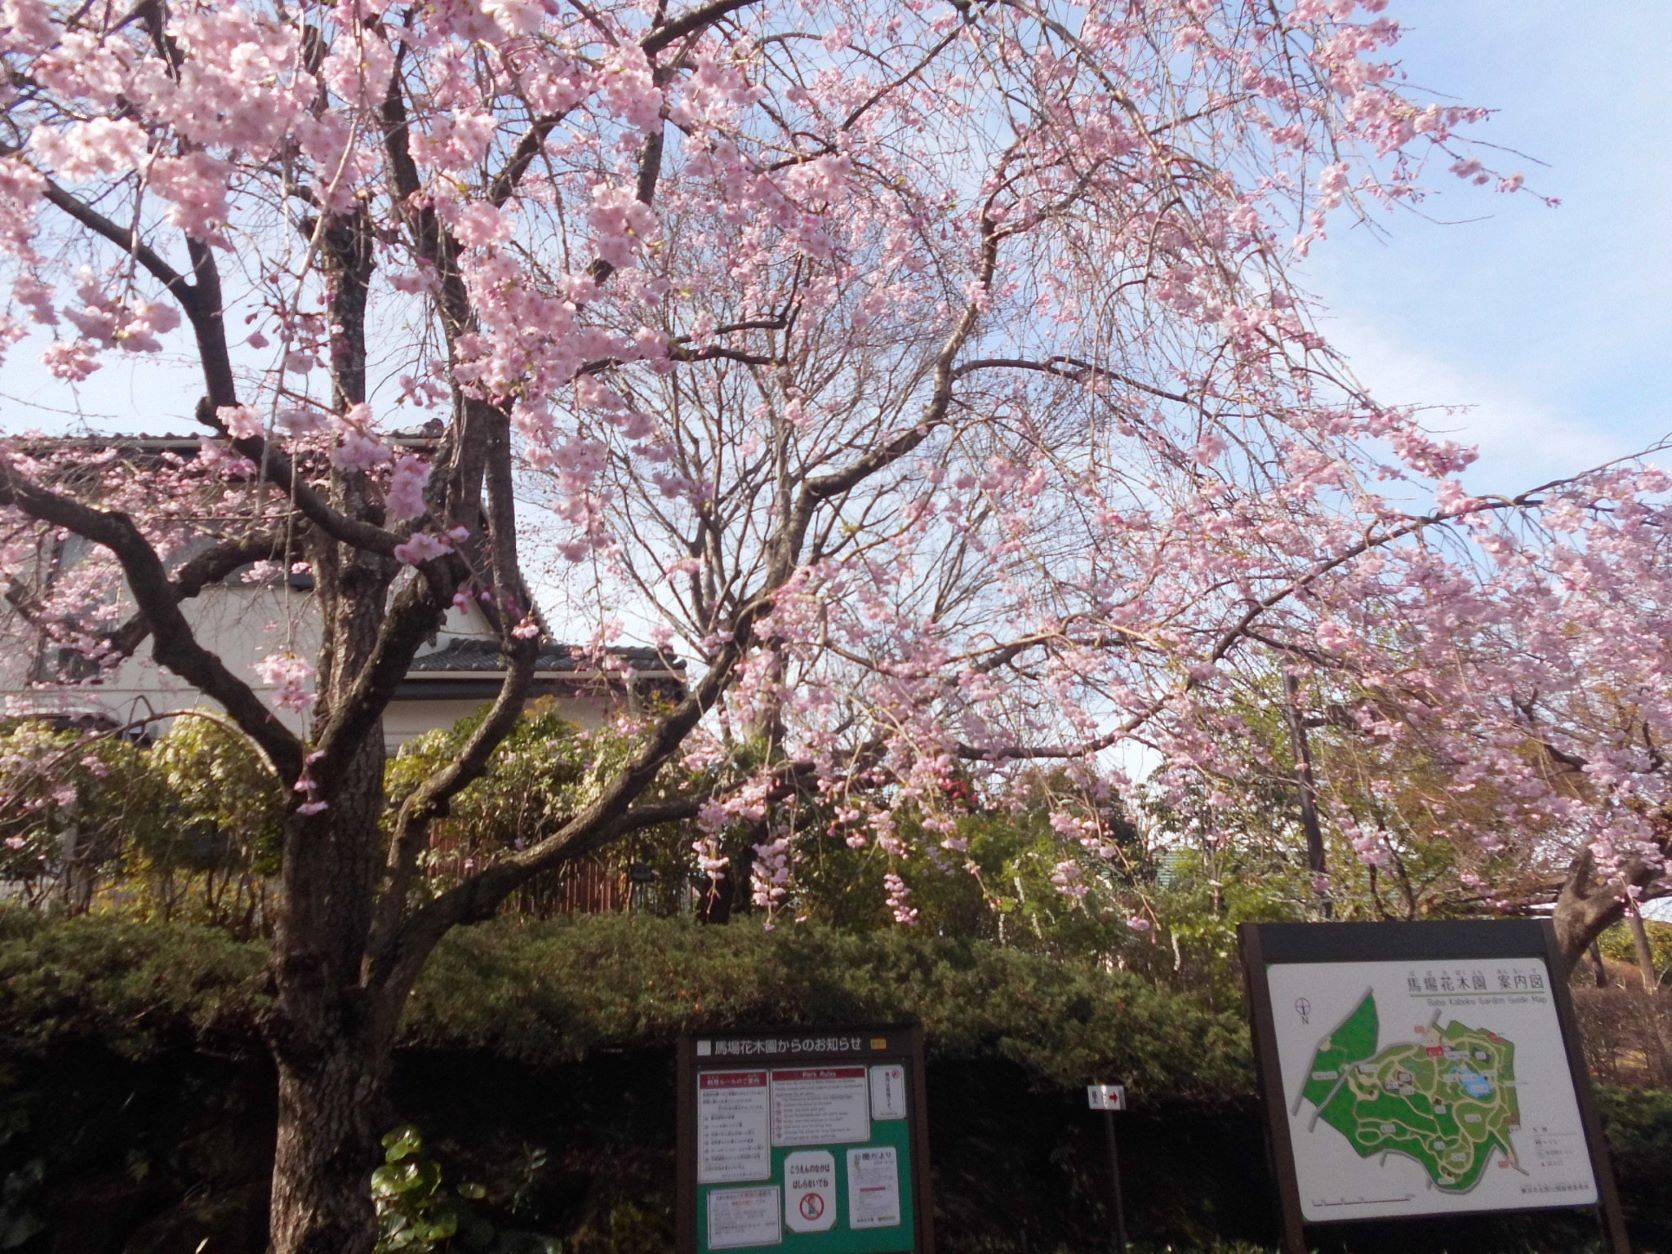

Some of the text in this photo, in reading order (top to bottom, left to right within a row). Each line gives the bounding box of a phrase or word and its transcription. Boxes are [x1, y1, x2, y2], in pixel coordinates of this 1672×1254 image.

[1301, 1016, 1309, 1024] N
[714, 1038, 862, 1056] 馬場花木園からのお知らせ
[790, 1164, 830, 1174] こうえんのなかは
